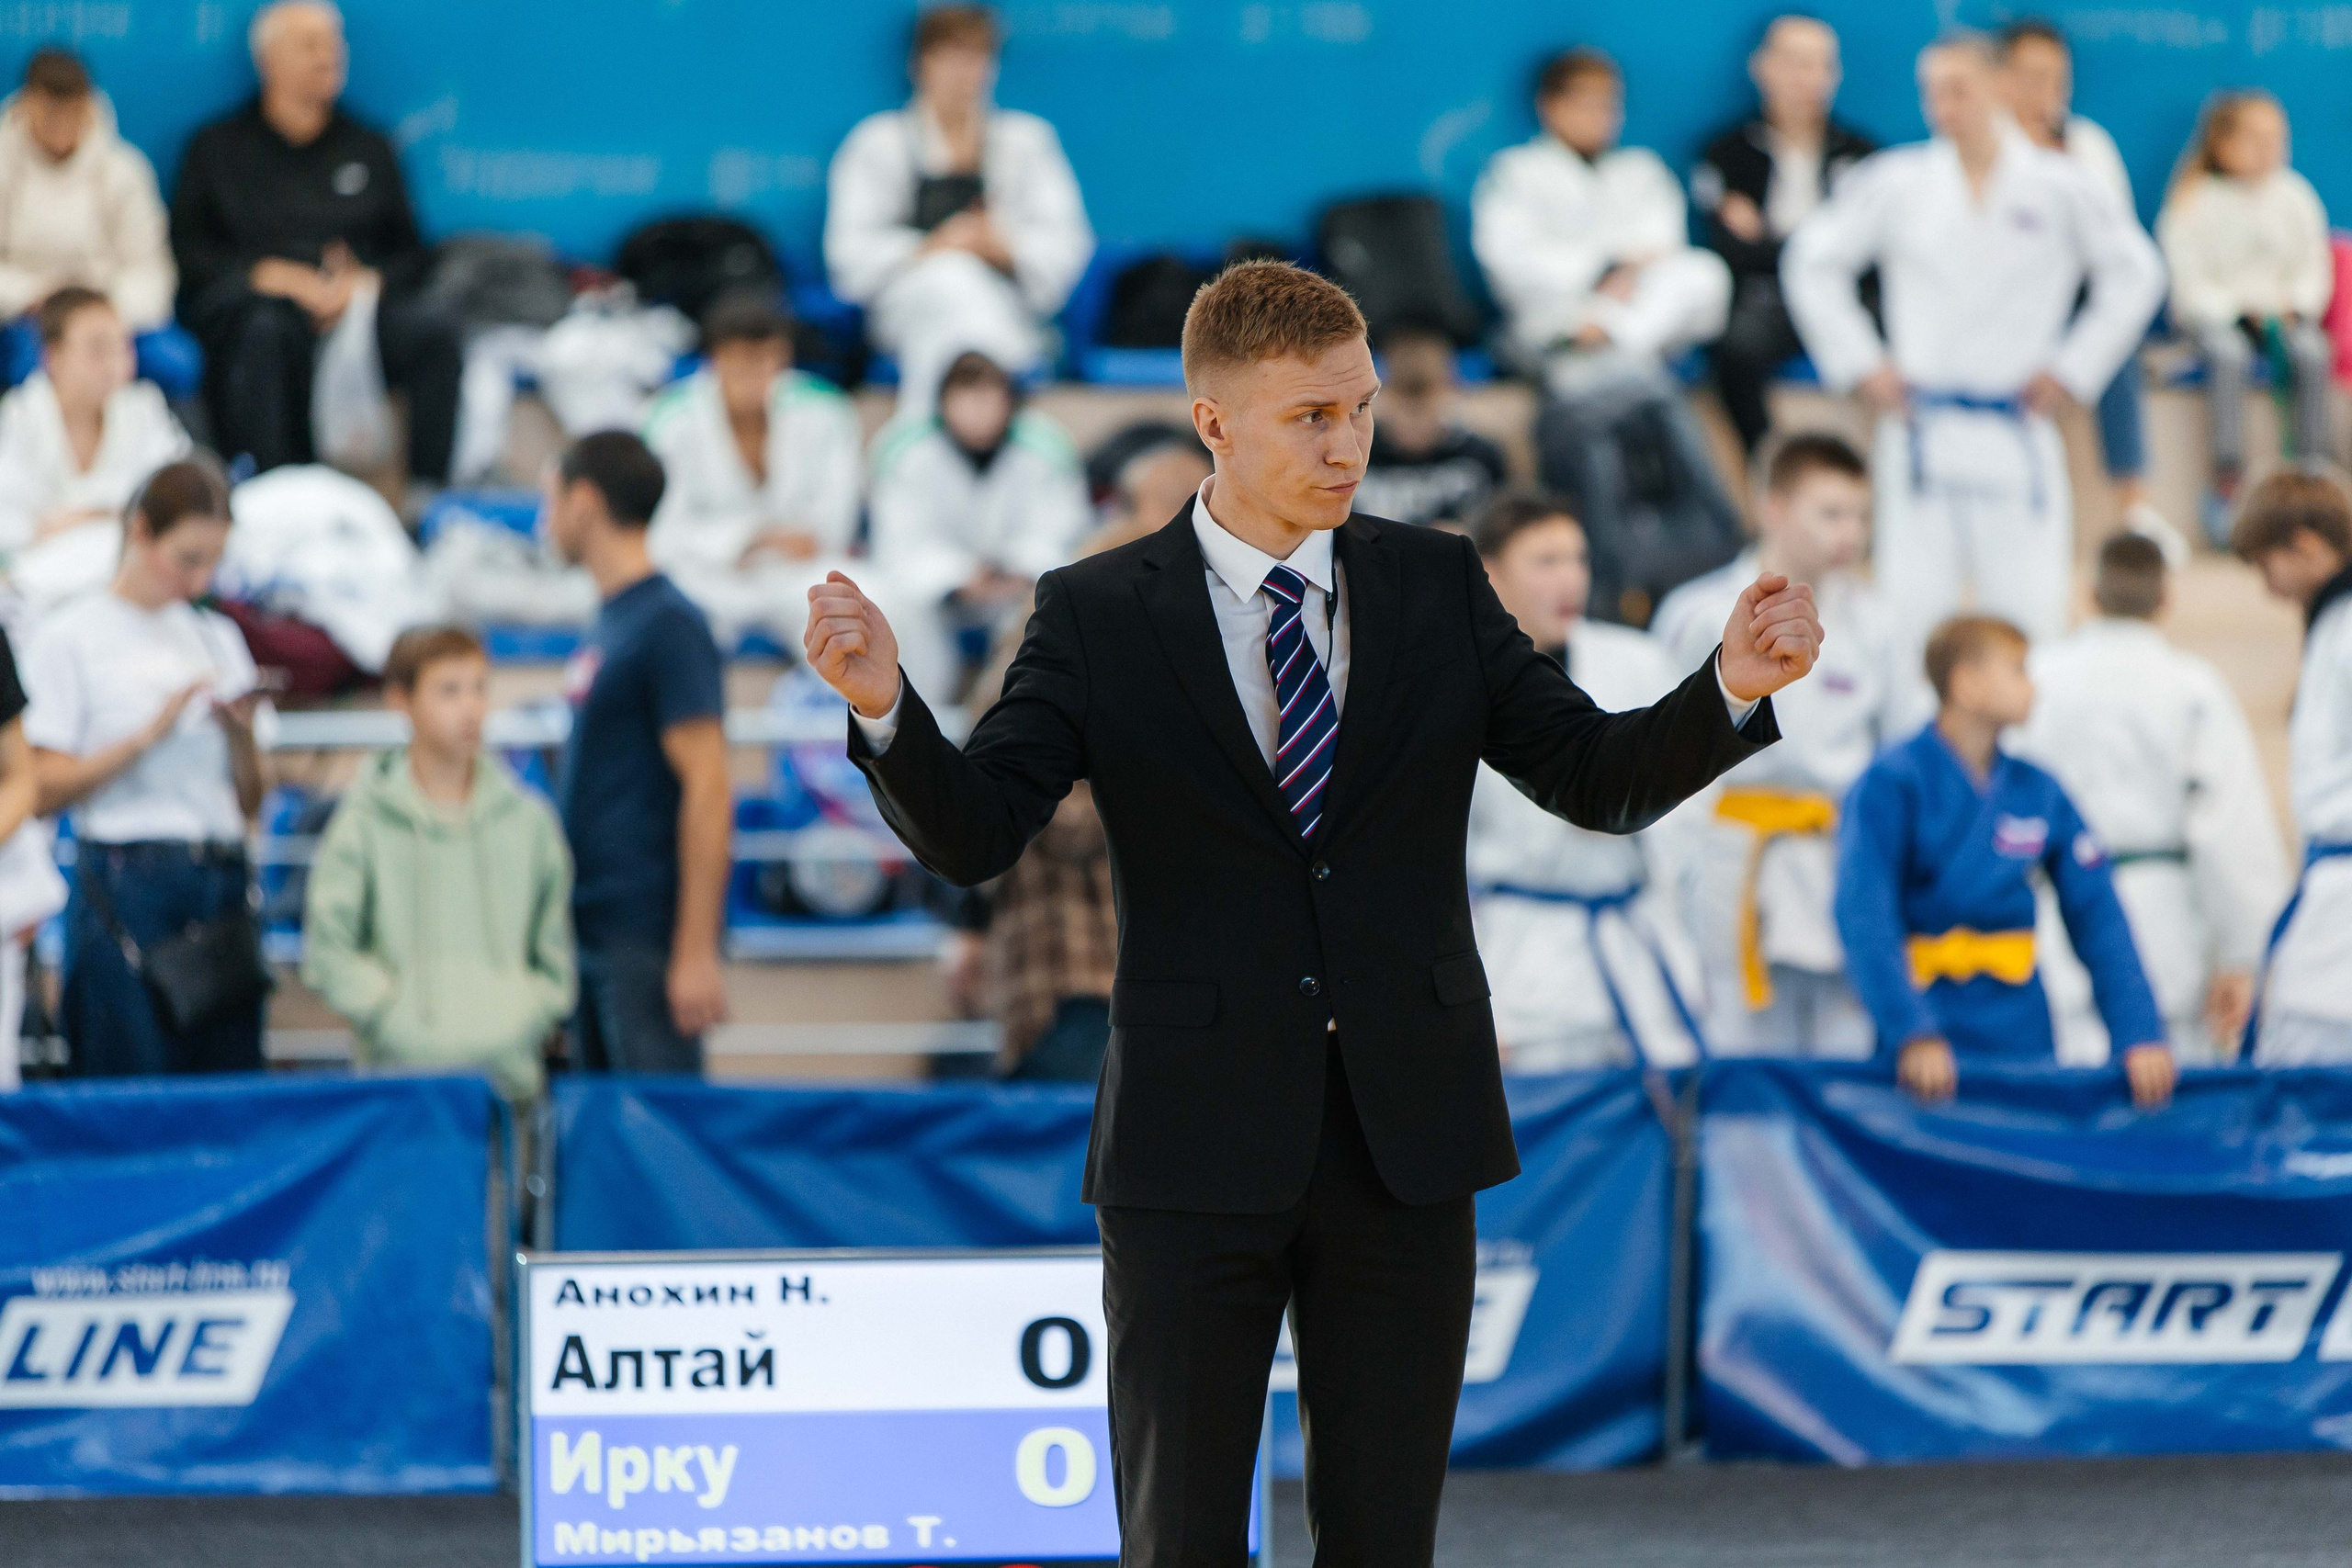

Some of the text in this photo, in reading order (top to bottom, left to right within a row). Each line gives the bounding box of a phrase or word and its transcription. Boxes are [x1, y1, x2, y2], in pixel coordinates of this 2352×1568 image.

[555, 1275, 831, 1308] Анохин Н.
[1928, 1280, 2309, 1335] START
[6, 1319, 245, 1380] LINE
[550, 1330, 775, 1391] Алтай
[549, 1430, 739, 1508] Ирку
[553, 1515, 957, 1561] Мирьязанов Т.
